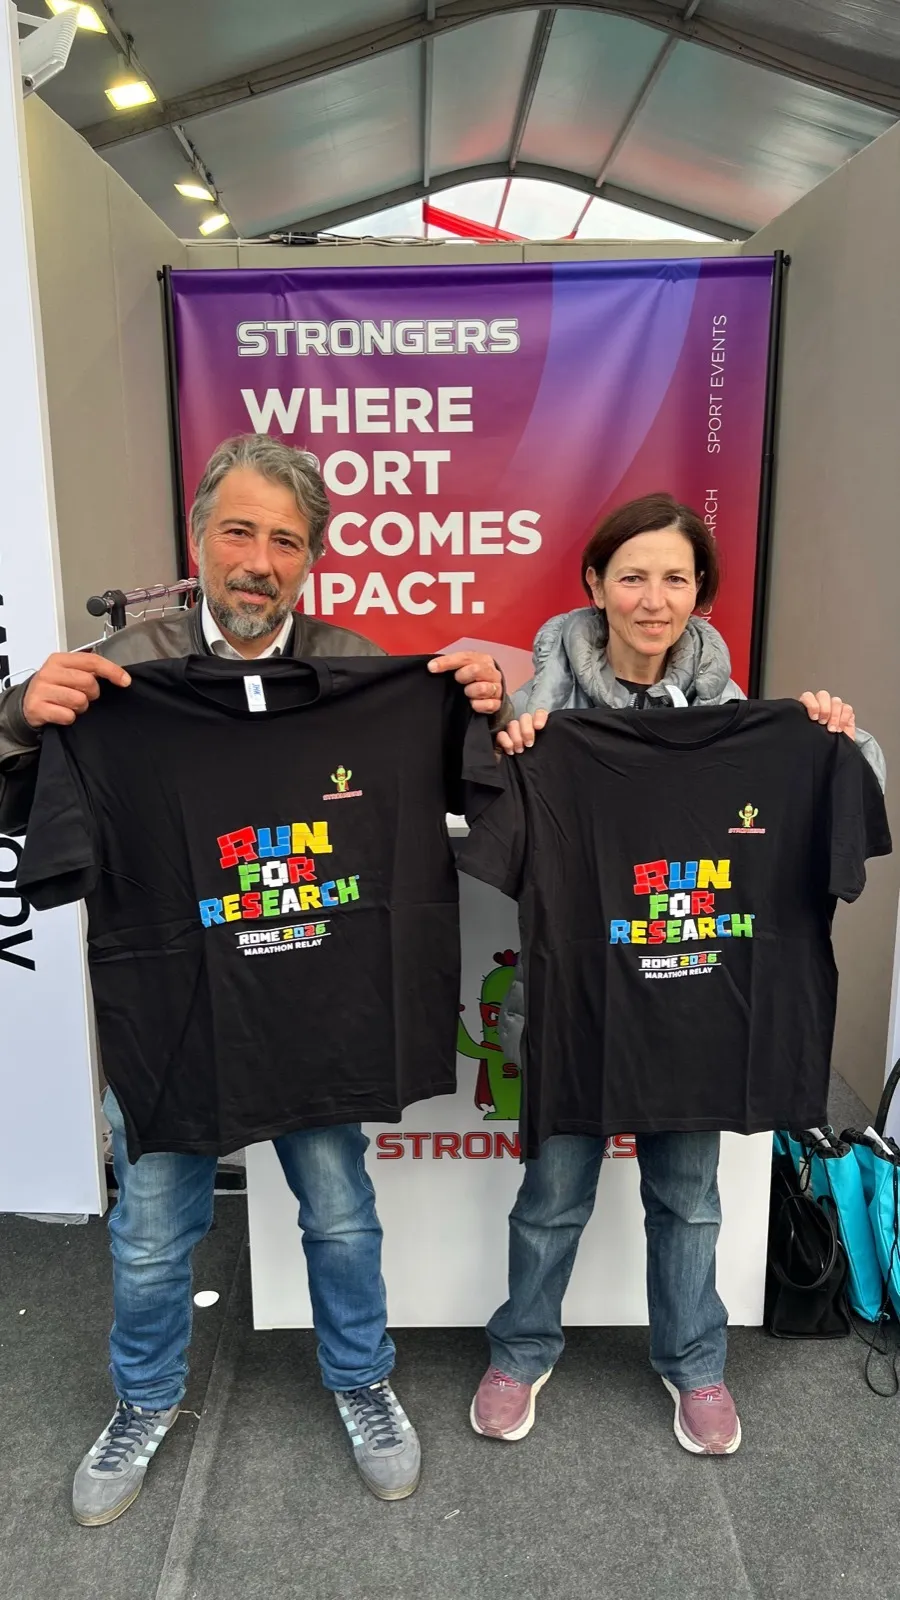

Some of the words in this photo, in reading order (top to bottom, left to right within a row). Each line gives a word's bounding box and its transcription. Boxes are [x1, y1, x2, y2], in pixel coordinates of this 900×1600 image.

[236, 318, 520, 357] STRONGERS
[710, 315, 727, 387] EVENTS
[240, 385, 474, 435] WHERE
[707, 394, 722, 453] SPORT
[304, 450, 451, 496] ORT
[322, 509, 543, 557] COMES
[217, 822, 333, 869] RUN
[237, 856, 318, 892] FOR
[633, 859, 732, 895] RUN
[198, 875, 361, 928] RESEARCH
[649, 891, 716, 919] FOR
[239, 931, 281, 946] ROME
[283, 923, 326, 940] 2026
[243, 943, 294, 956] MARATHON
[295, 938, 323, 949] RELAY
[609, 914, 754, 945] RESEARCH
[641, 957, 679, 969] ROME
[680, 953, 718, 966] 2026
[644, 969, 688, 979] MARATHON
[689, 966, 714, 976] RELAY
